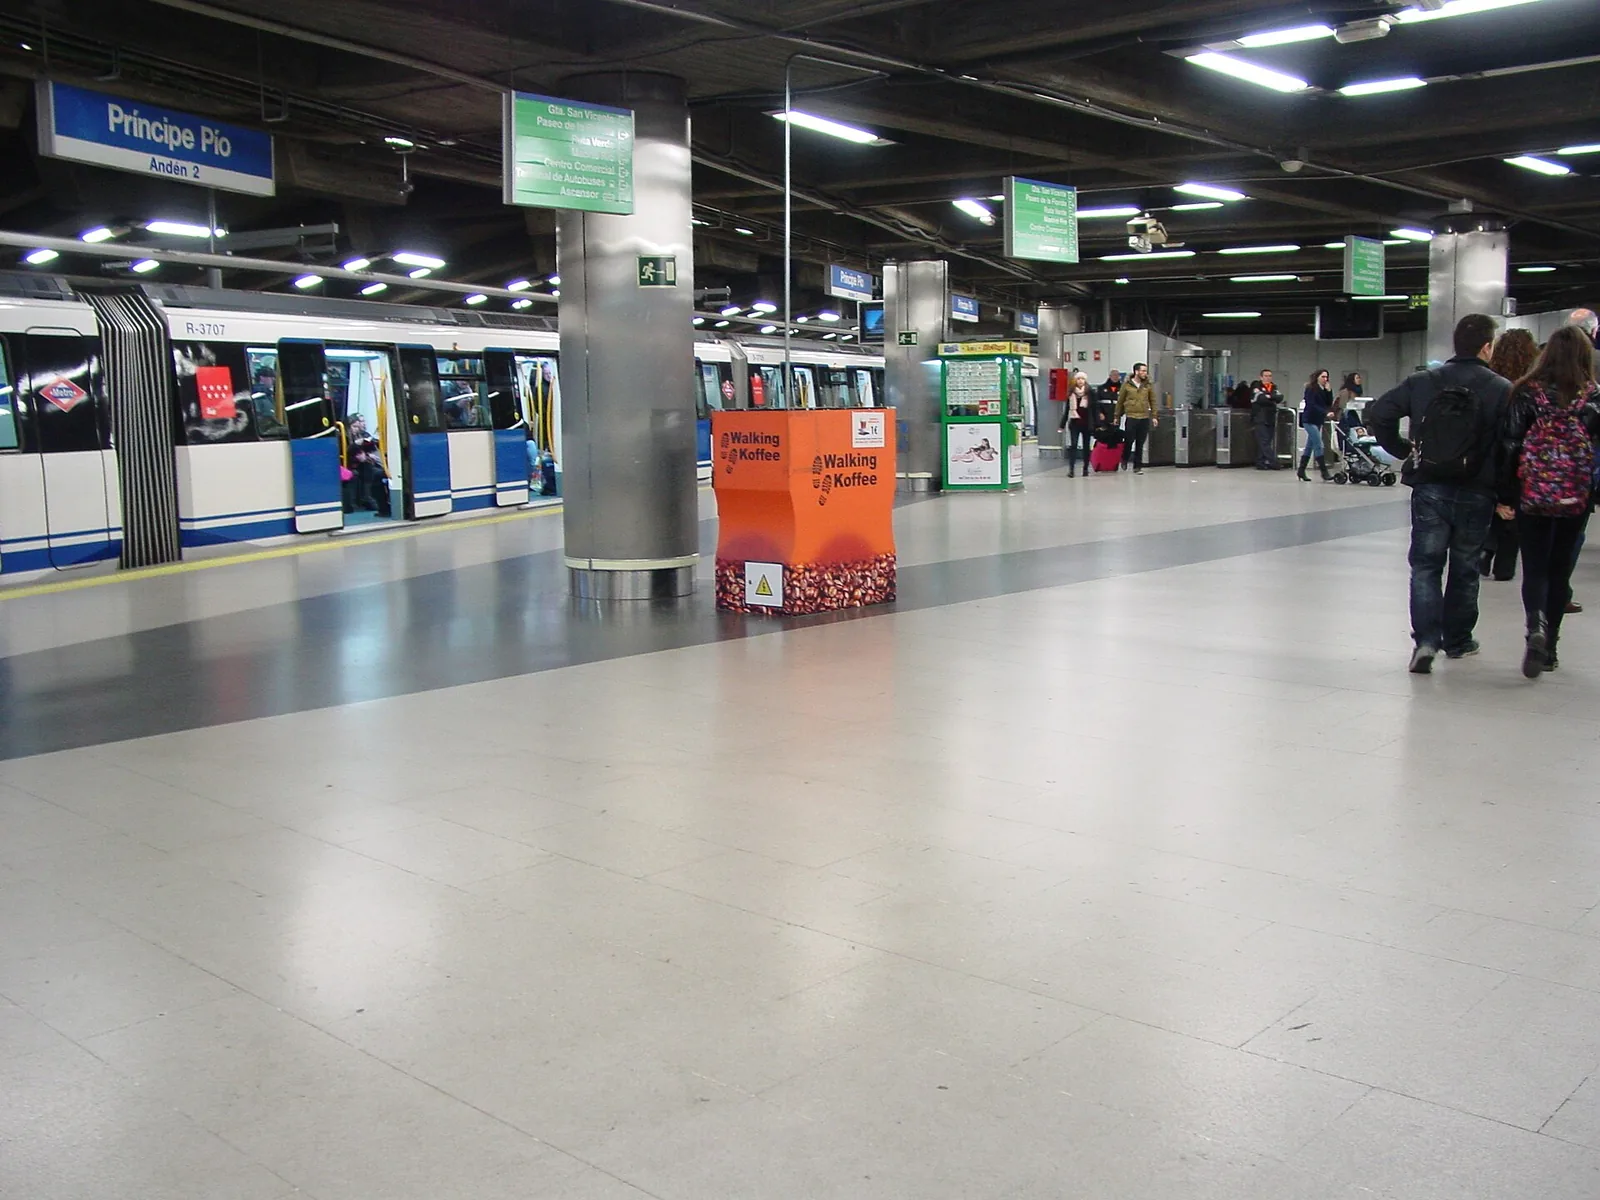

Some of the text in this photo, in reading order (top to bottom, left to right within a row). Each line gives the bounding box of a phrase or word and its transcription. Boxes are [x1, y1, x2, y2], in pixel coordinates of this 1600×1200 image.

[547, 103, 566, 116] Gta.
[567, 107, 584, 119] San
[108, 103, 231, 157] Príncipe Pío
[536, 116, 563, 129] Paseo
[564, 120, 576, 130] de
[150, 157, 200, 178] Andén 2
[543, 157, 616, 176] Centro Comercial
[552, 171, 564, 182] de
[564, 172, 606, 187] Autobuses
[560, 186, 600, 199] Ascensor
[186, 322, 226, 336] R-3707
[730, 431, 780, 447] Walking
[739, 448, 780, 461] Koffee
[823, 452, 877, 470] Walking
[833, 472, 878, 488] Koffee
